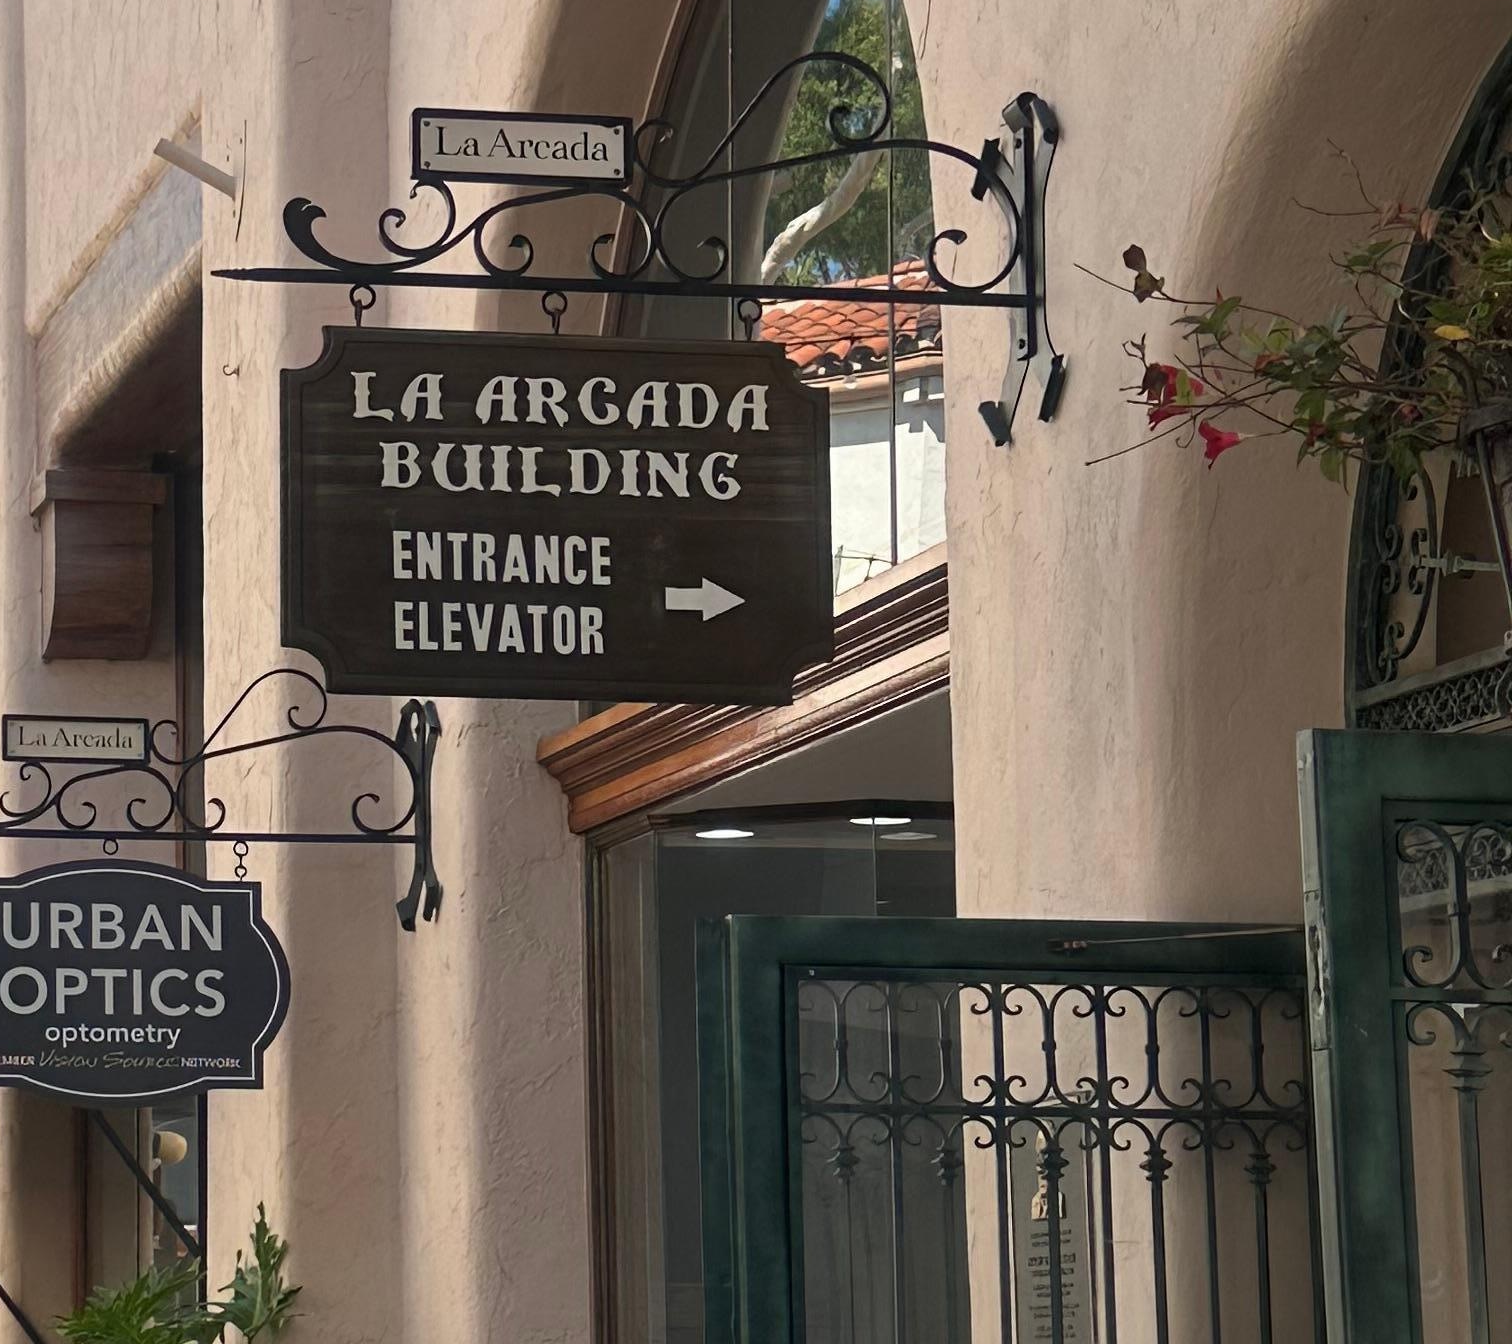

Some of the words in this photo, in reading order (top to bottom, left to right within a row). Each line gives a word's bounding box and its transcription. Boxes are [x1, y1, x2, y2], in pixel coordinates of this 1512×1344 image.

[435, 126, 480, 157] La
[488, 128, 609, 162] Arcada
[350, 370, 444, 422] LA
[474, 375, 770, 433] ARCADA
[379, 441, 742, 500] BUILDING
[392, 529, 612, 586] ENTRANCE
[394, 600, 605, 655] ELEVATOR
[18, 726, 46, 746] La
[53, 727, 133, 749] Arcada
[2, 901, 223, 952] URBAN
[45, 1023, 181, 1049] optometry
